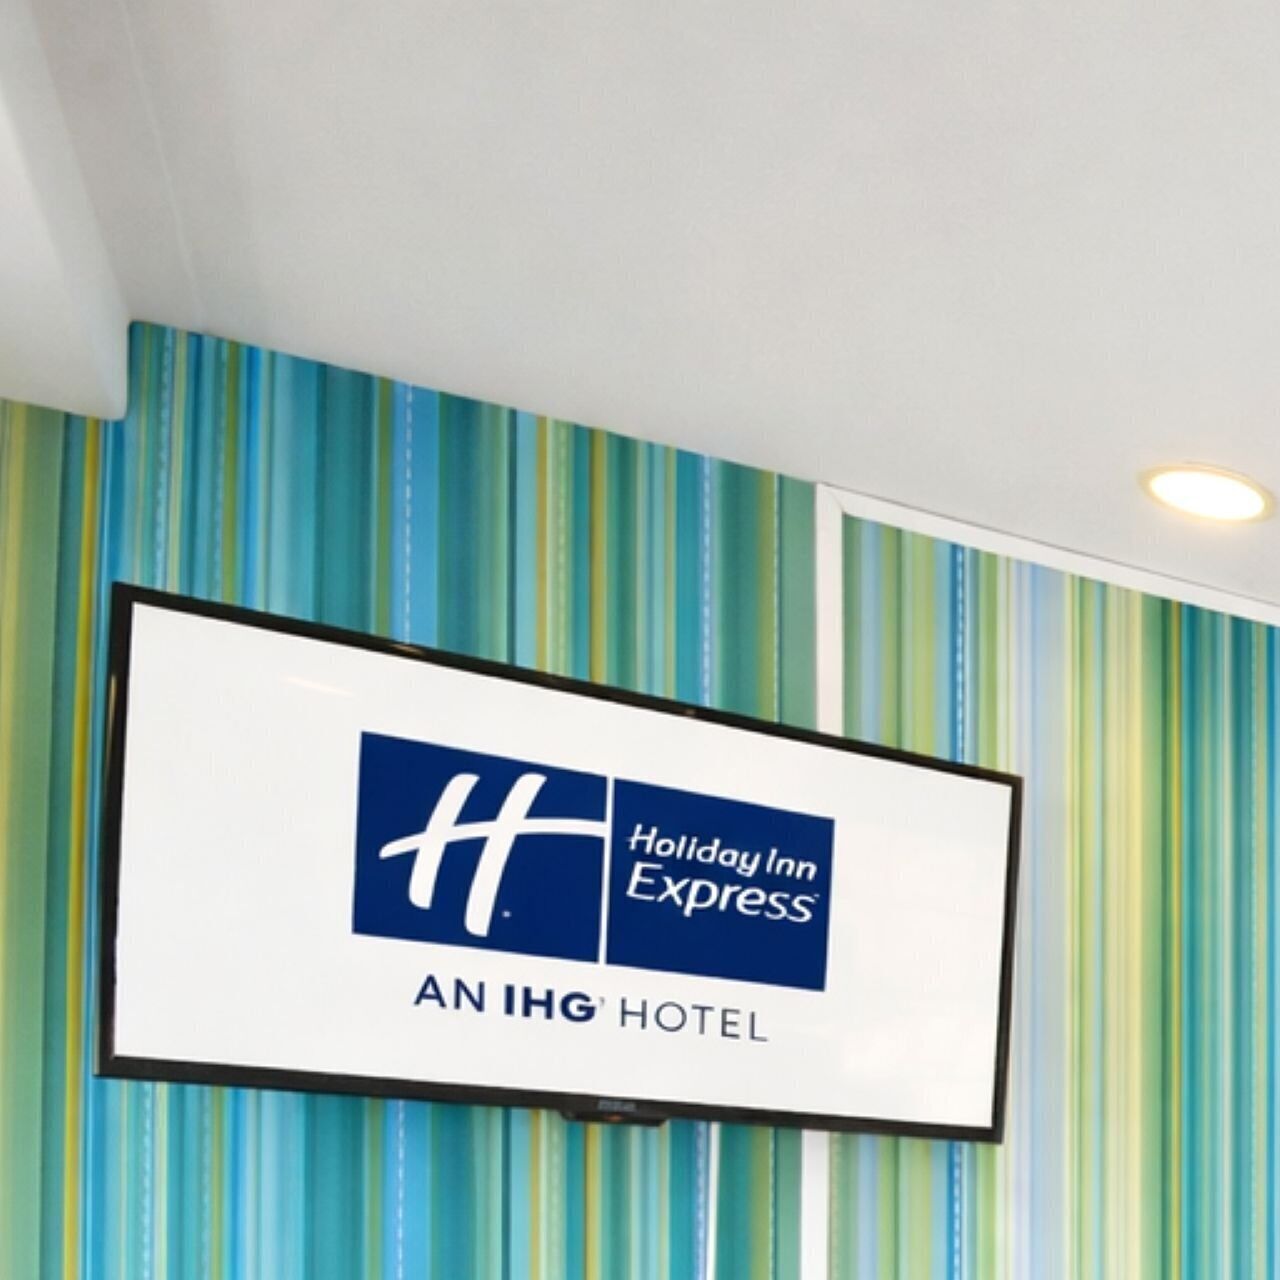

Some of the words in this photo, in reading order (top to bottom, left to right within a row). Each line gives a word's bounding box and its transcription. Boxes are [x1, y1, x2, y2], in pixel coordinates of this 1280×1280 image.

[626, 823, 762, 878] Holiday
[765, 848, 818, 882] Inn
[626, 861, 818, 923] Express
[413, 973, 487, 1013] AN
[503, 983, 597, 1023] IHG
[619, 997, 769, 1042] HOTEL
